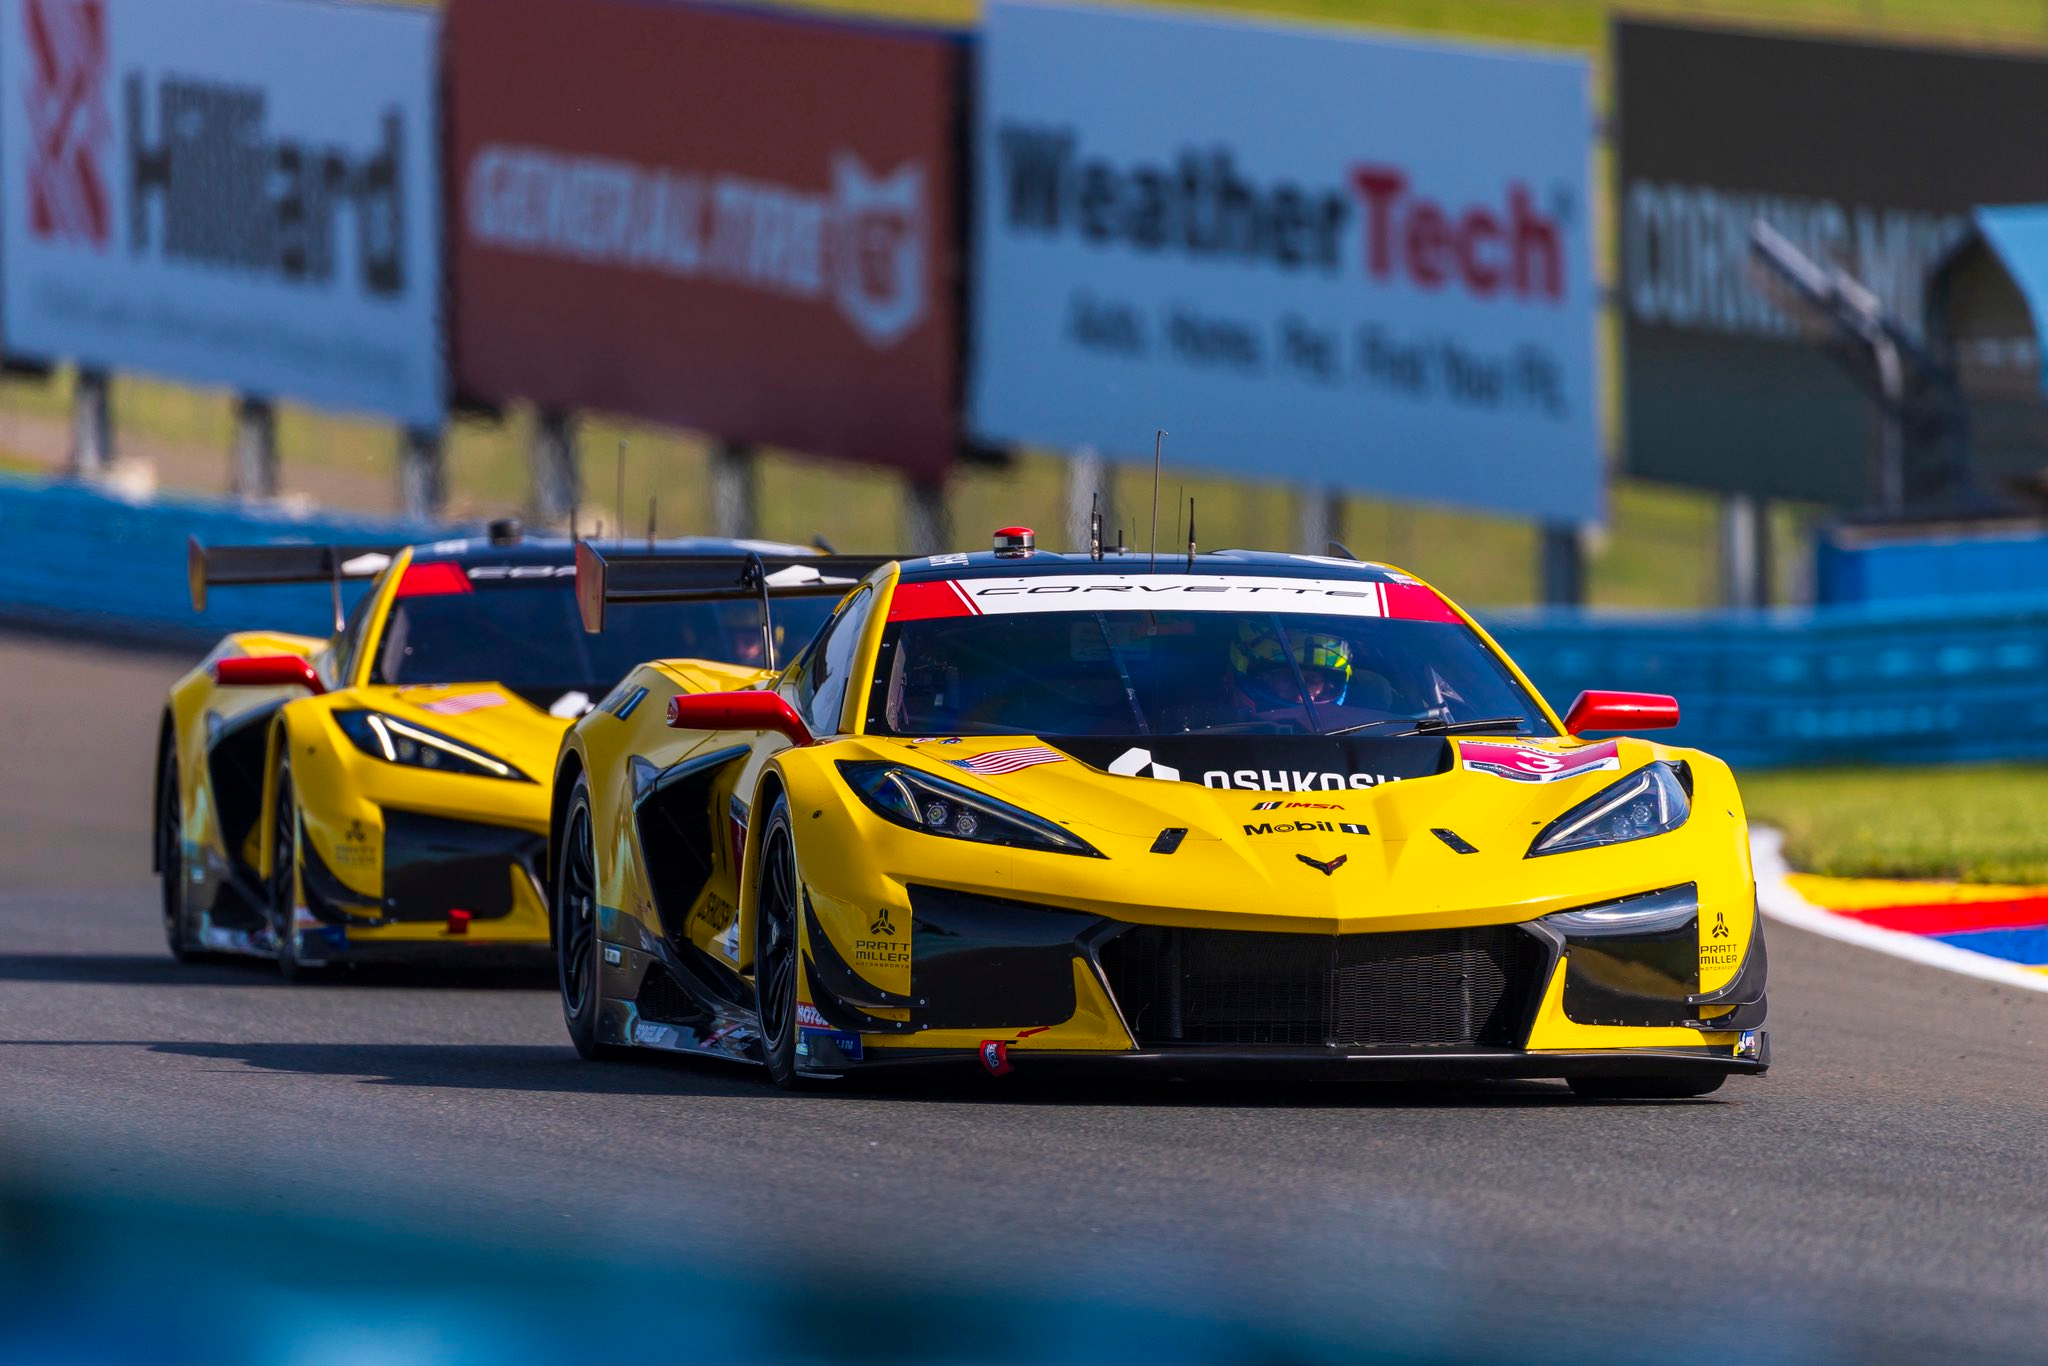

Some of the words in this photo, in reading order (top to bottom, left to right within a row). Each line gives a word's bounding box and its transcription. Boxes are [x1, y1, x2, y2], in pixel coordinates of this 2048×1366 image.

[1000, 122, 1563, 304] WeatherTech
[976, 585, 1369, 598] CORVETTE
[1515, 751, 1565, 772] 3
[1284, 802, 1346, 811] IMSA
[1242, 821, 1334, 836] Mobil
[856, 940, 911, 952] PRATT
[1700, 944, 1737, 954] PRATT
[856, 951, 910, 962] MILLER
[1700, 955, 1737, 965] MILLER
